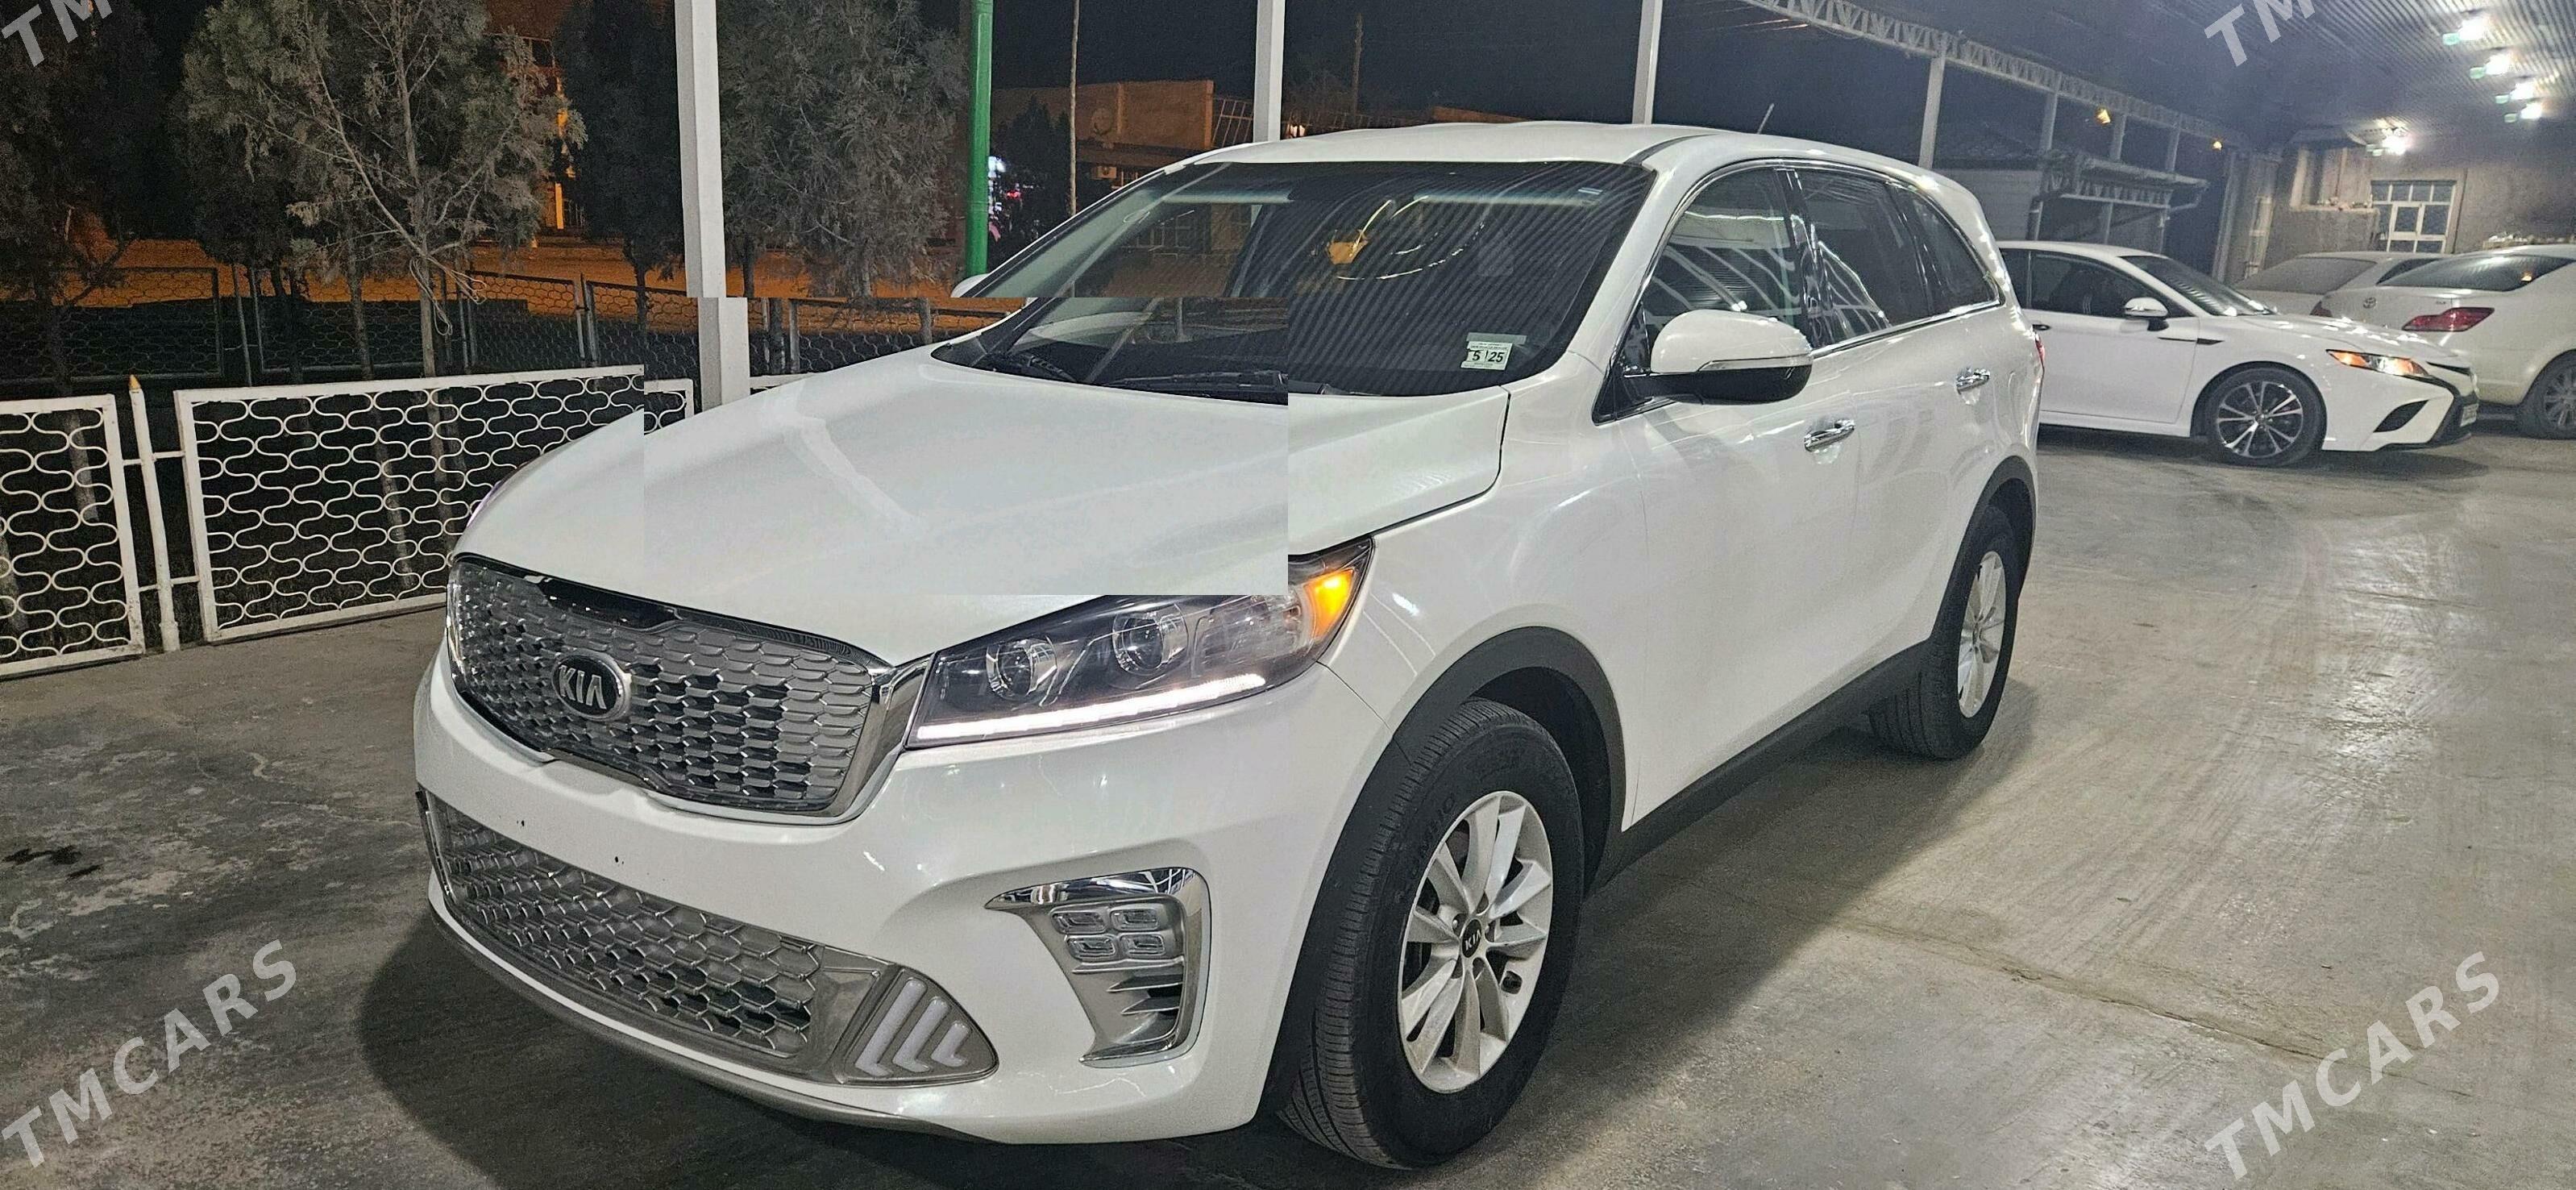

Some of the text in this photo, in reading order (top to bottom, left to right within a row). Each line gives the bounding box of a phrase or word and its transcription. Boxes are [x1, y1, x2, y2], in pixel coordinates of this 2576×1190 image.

[1472, 350, 1505, 363] 5 25
[559, 665, 607, 709] KIA
[1465, 929, 1481, 951] KIA
